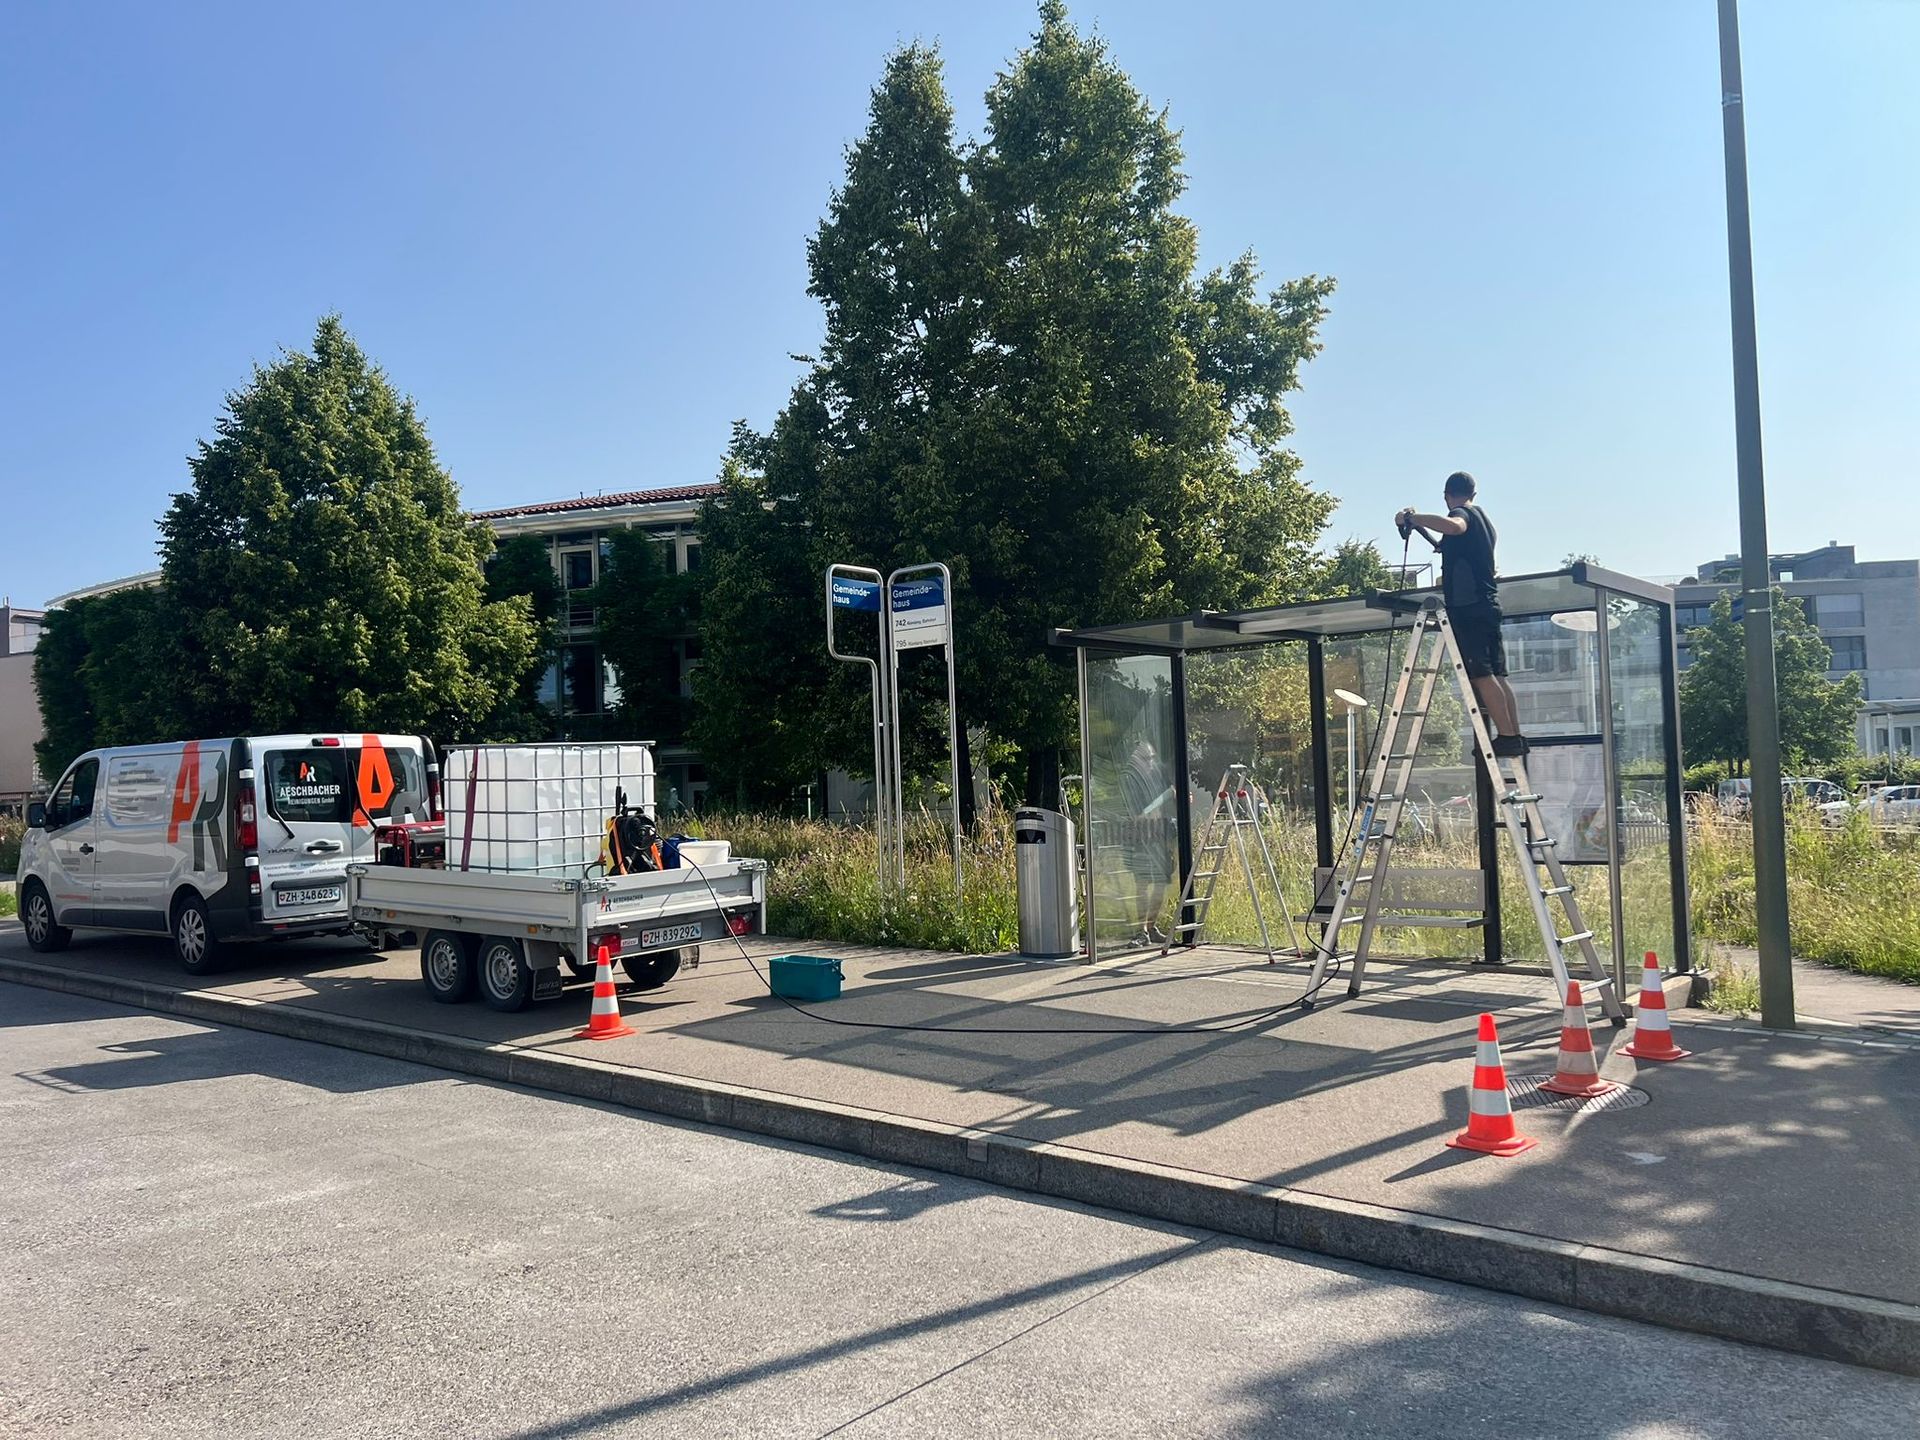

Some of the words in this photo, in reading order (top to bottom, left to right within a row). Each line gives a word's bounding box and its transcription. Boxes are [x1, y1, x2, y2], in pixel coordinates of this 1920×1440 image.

[833, 584, 870, 597] Gemeinde-
[892, 586, 932, 599] Gemeinde-
[833, 594, 850, 604] haus
[892, 599, 910, 608] haus
[896, 619, 907, 627] 742
[300, 762, 316, 782] AR
[280, 785, 341, 797] AESCHBACHER
